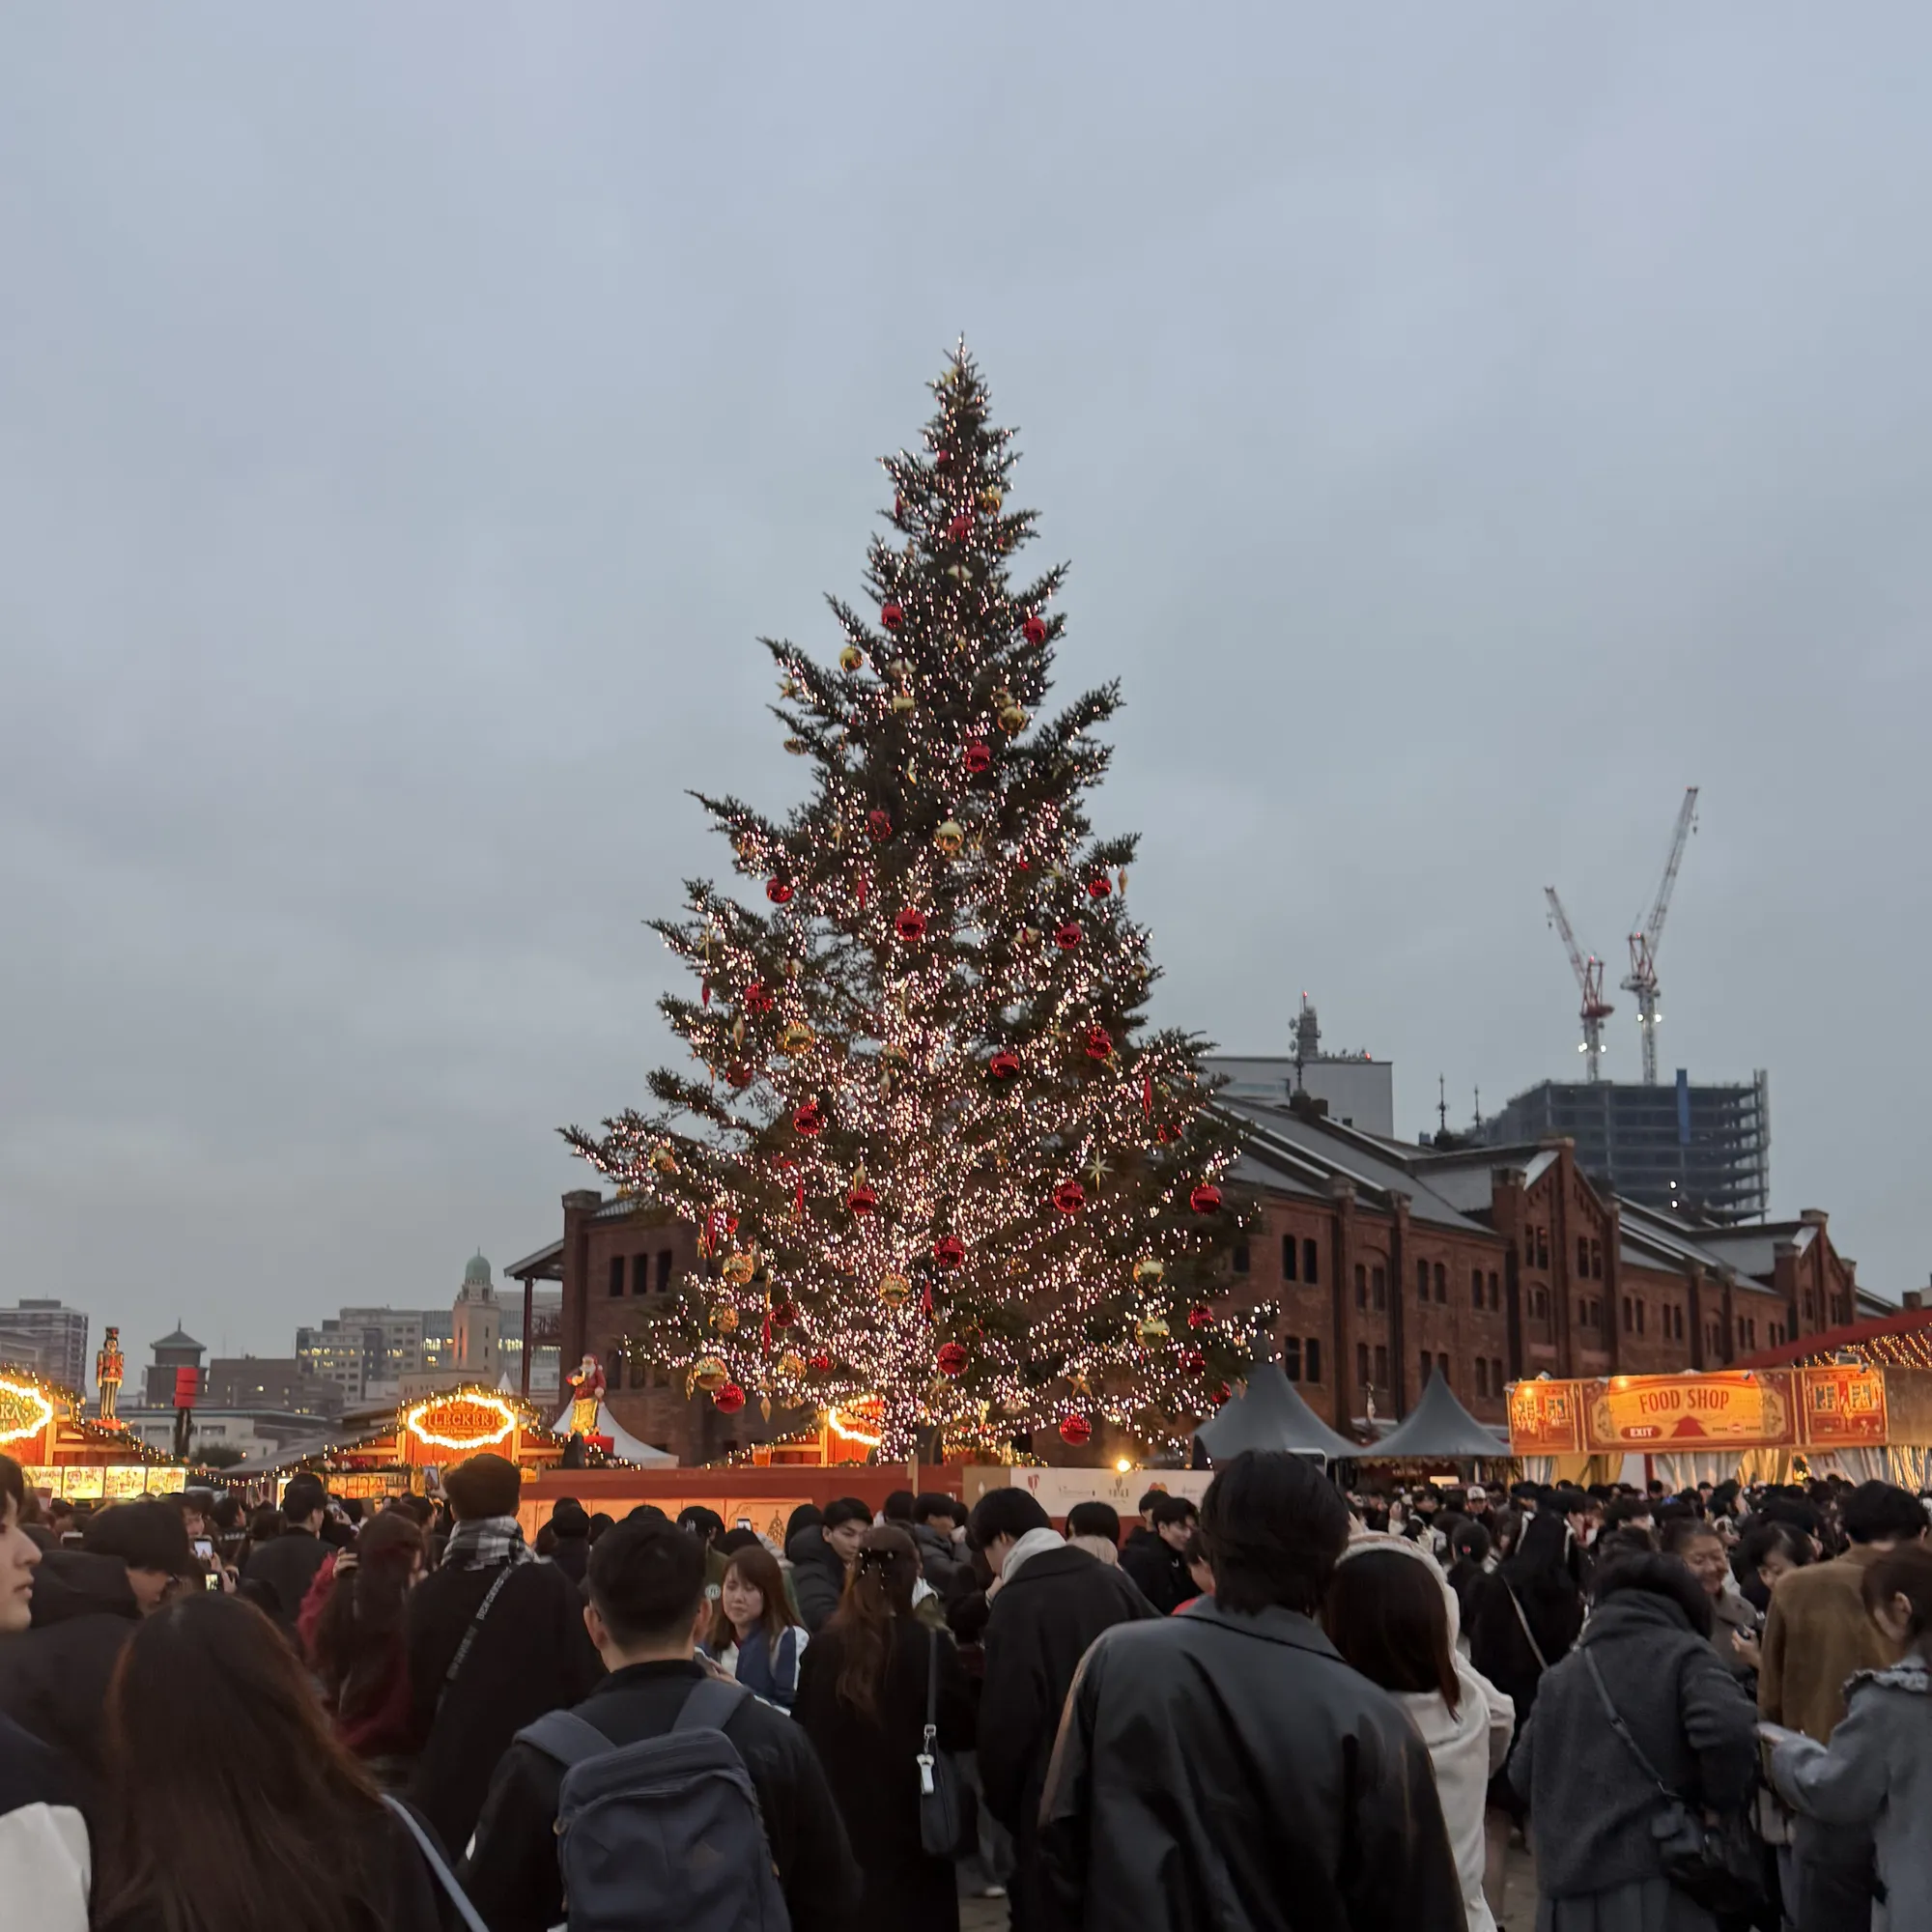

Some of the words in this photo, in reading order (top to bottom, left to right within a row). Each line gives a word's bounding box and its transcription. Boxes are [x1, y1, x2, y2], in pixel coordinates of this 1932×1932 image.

[1639, 1389, 1681, 1414] FOOD
[1687, 1388, 1729, 1410] SHOP
[435, 1413, 490, 1426] LECKER
[1630, 1427, 1653, 1437] EXIT
